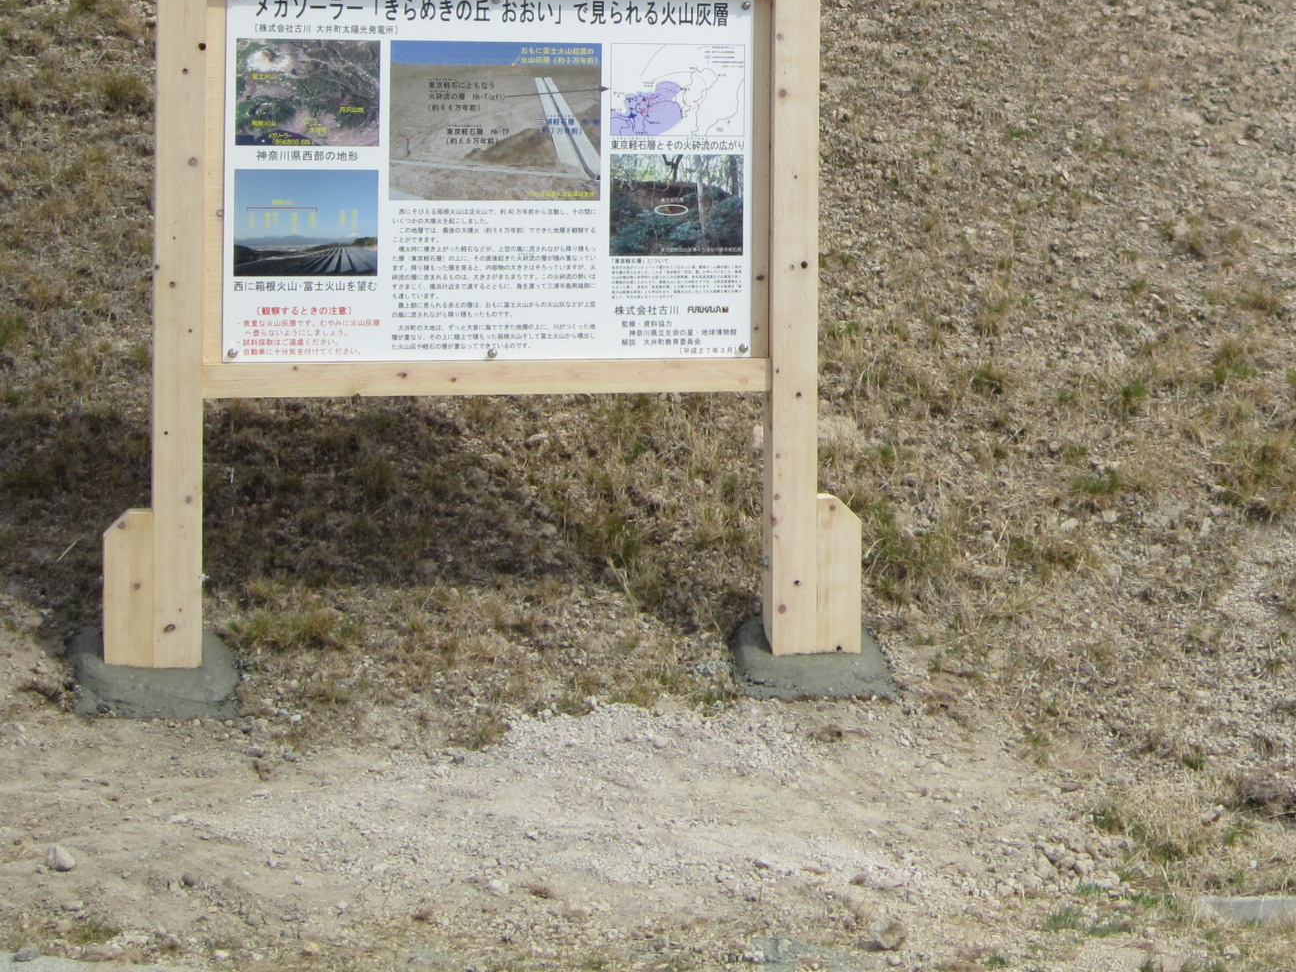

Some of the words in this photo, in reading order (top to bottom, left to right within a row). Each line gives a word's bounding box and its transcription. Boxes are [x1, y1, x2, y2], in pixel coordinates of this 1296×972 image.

[611, 140, 745, 151] 東京軽石層とその火砕流の広がり
[256, 150, 359, 161] 神奈川県西部の地形
[233, 280, 378, 292] 西に箱根火山・富士火山を望む
[614, 305, 679, 316] 株式会社古川
[621, 320, 673, 328] 監修・資料協力
[629, 328, 738, 337] 神奈川県立生命の星・地球博物館
[643, 338, 701, 346] 大井町教育委員会
